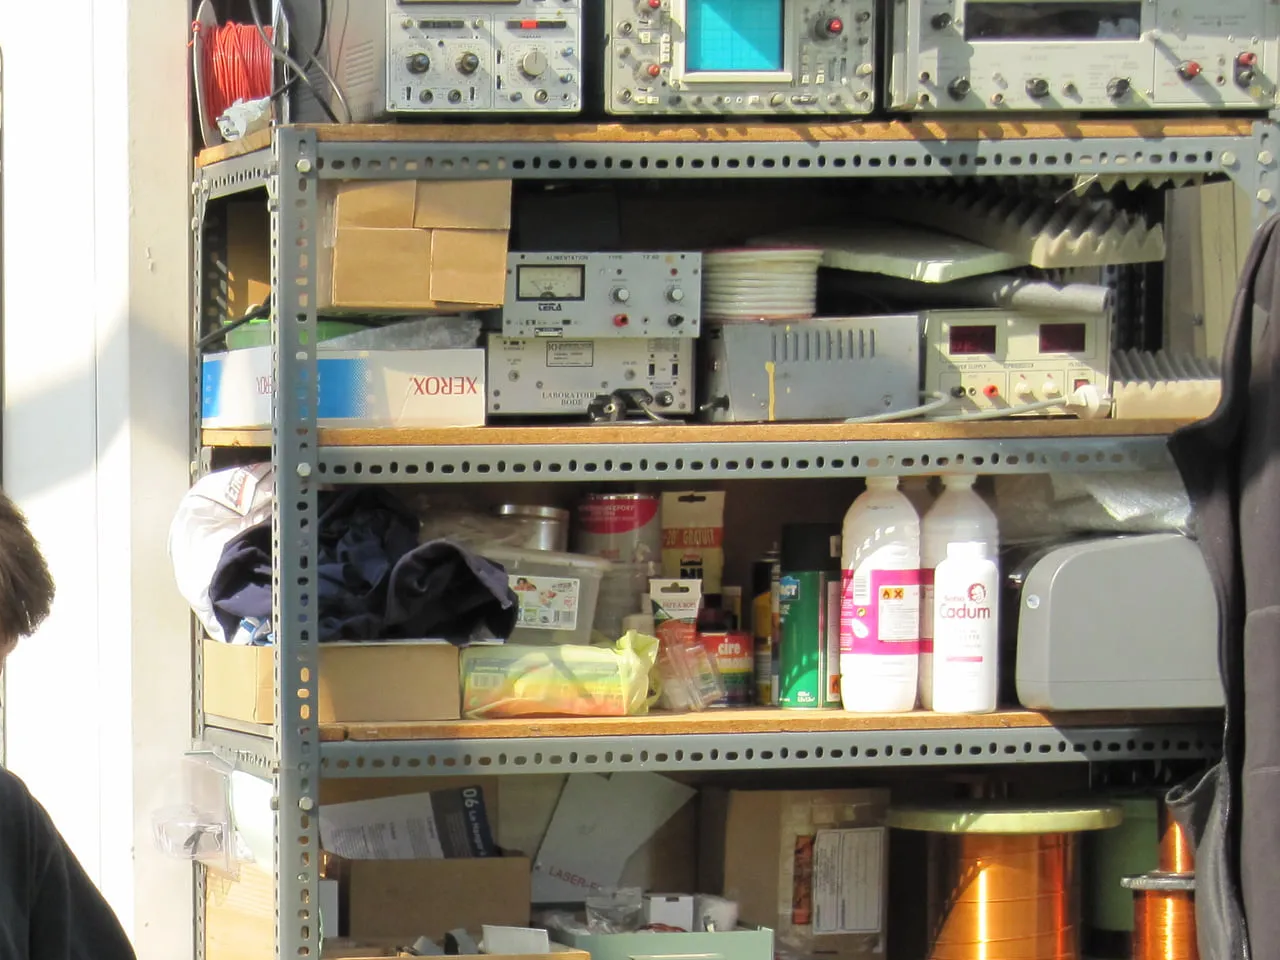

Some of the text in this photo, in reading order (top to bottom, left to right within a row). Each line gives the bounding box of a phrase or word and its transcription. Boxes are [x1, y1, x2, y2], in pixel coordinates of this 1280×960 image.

[412, 375, 478, 396] XEROX
[939, 603, 991, 620] Cadum
[462, 788, 479, 808] 06
